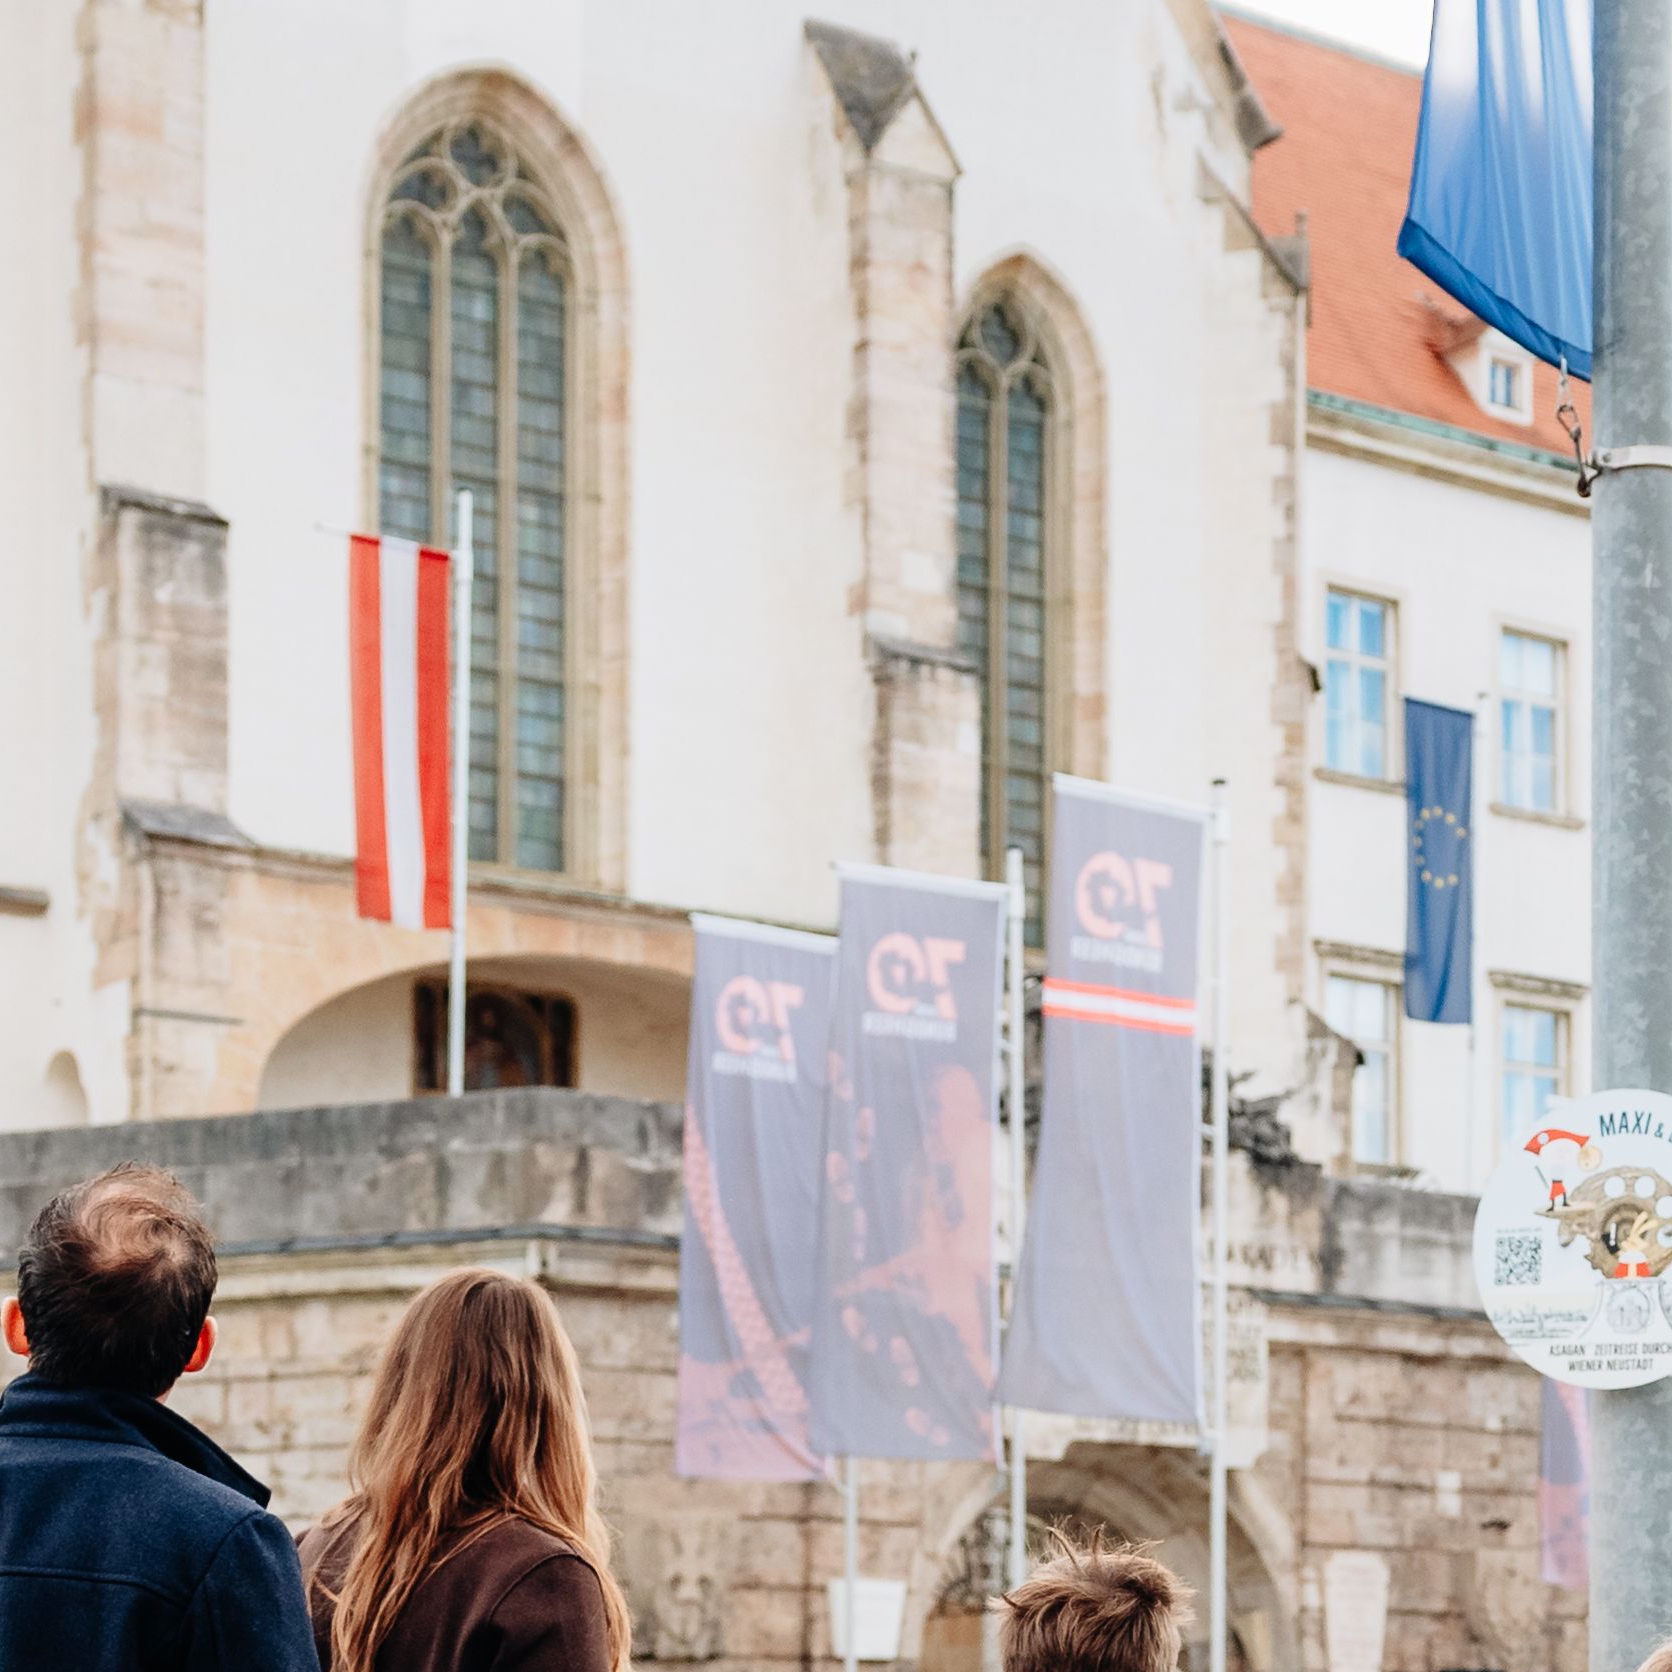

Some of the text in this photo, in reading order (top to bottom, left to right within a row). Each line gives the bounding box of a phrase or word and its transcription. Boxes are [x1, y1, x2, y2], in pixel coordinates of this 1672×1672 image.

[1599, 1111, 1653, 1137] MAXI
[1654, 1122, 1664, 1138] &
[1607, 1358, 1654, 1371] NEUSTADT
